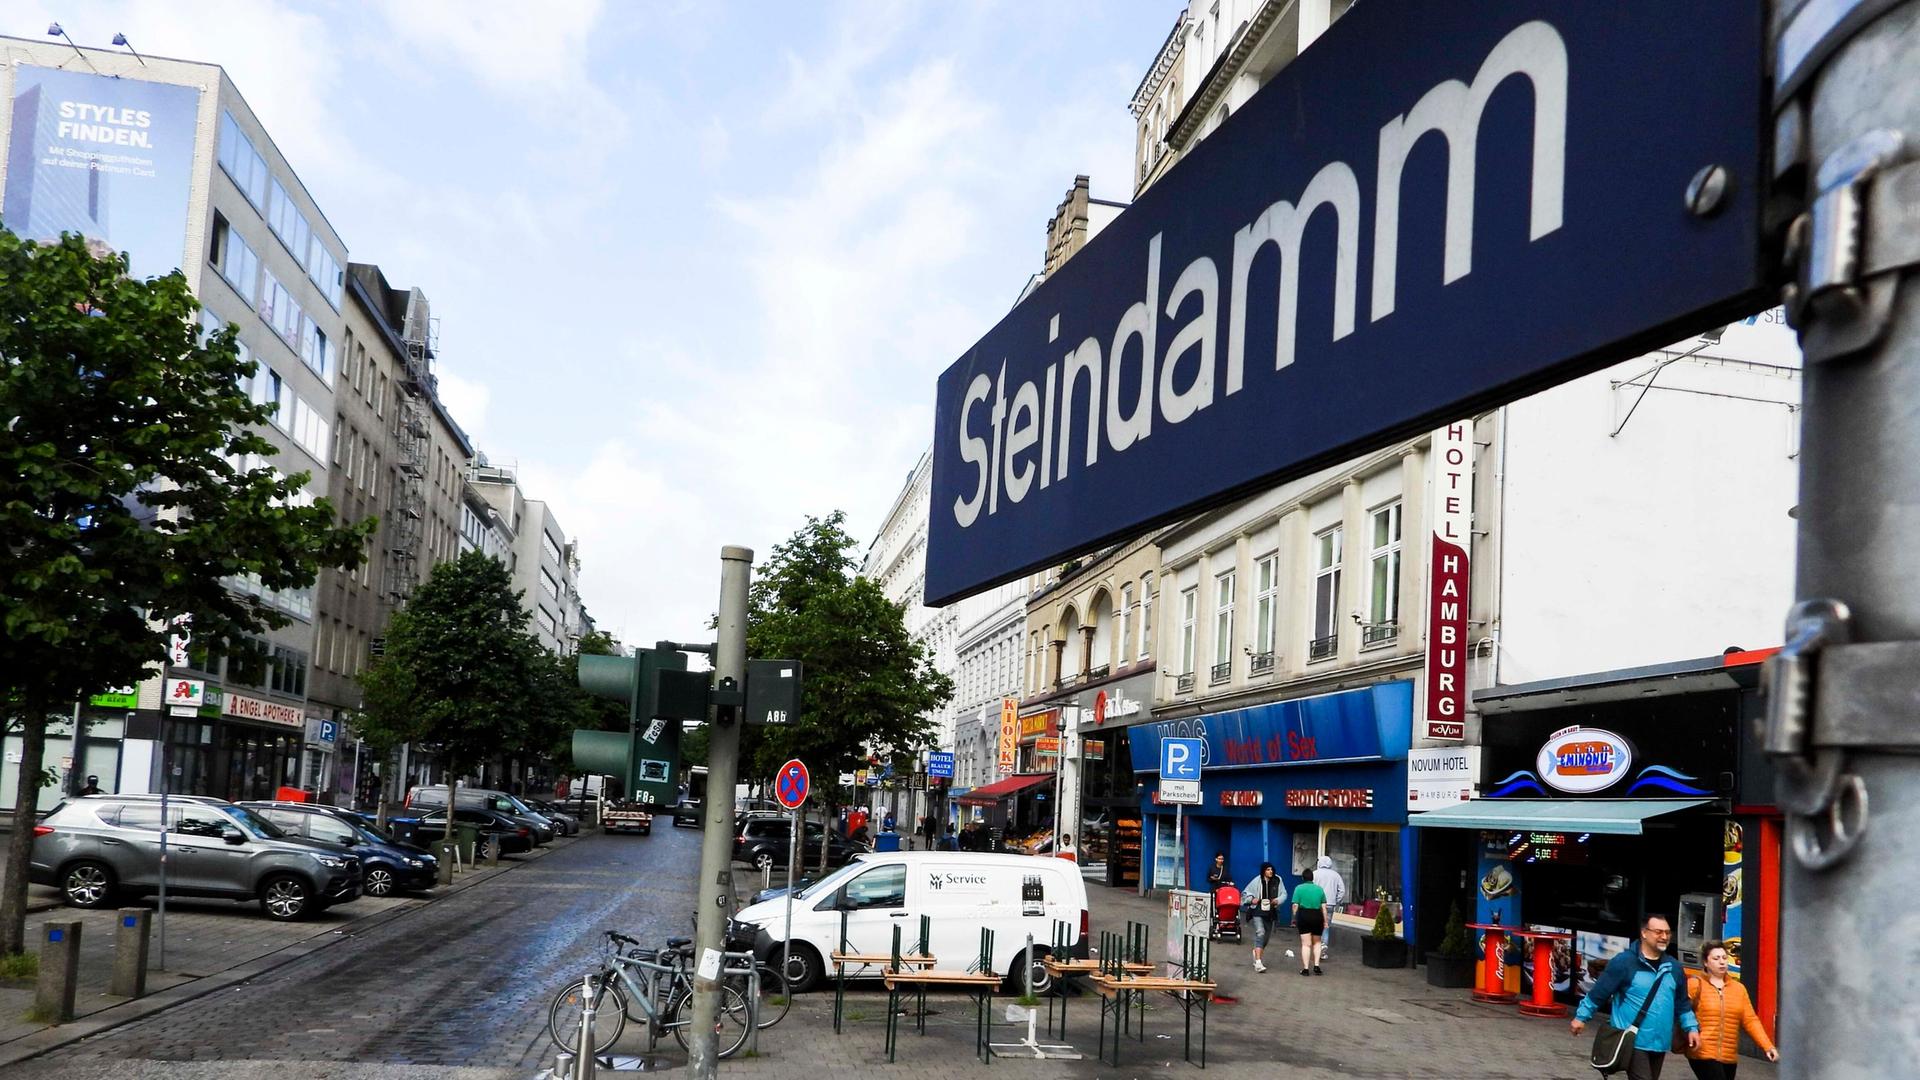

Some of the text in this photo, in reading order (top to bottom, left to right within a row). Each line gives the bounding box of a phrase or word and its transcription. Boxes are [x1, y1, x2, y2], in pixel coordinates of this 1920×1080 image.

[59, 101, 151, 128] STYLES
[58, 121, 153, 149] FINDEN.
[132, 166, 156, 177] Card
[952, 19, 1570, 530] Steindamm
[1446, 423, 1463, 538] HOTEL
[1438, 555, 1458, 716] HAMBURG
[240, 699, 261, 717] ENGEL
[263, 704, 295, 723] APOTHEKE
[766, 710, 788, 722] A8b
[1001, 699, 1014, 762] KIOSK
[1432, 725, 1460, 736] NOVUM
[1224, 735, 1262, 763] World
[1267, 733, 1282, 761] of
[1287, 729, 1317, 759] Sex
[930, 754, 953, 762] HOTEL
[1168, 744, 1189, 774] P
[1411, 757, 1468, 771] NOVUM HOTEL
[1000, 764, 1013, 773] 25
[635, 789, 655, 804] F8a
[1162, 790, 1197, 799] Parkschein
[1420, 791, 1458, 799] HAMBURG
[946, 873, 987, 884] Service
